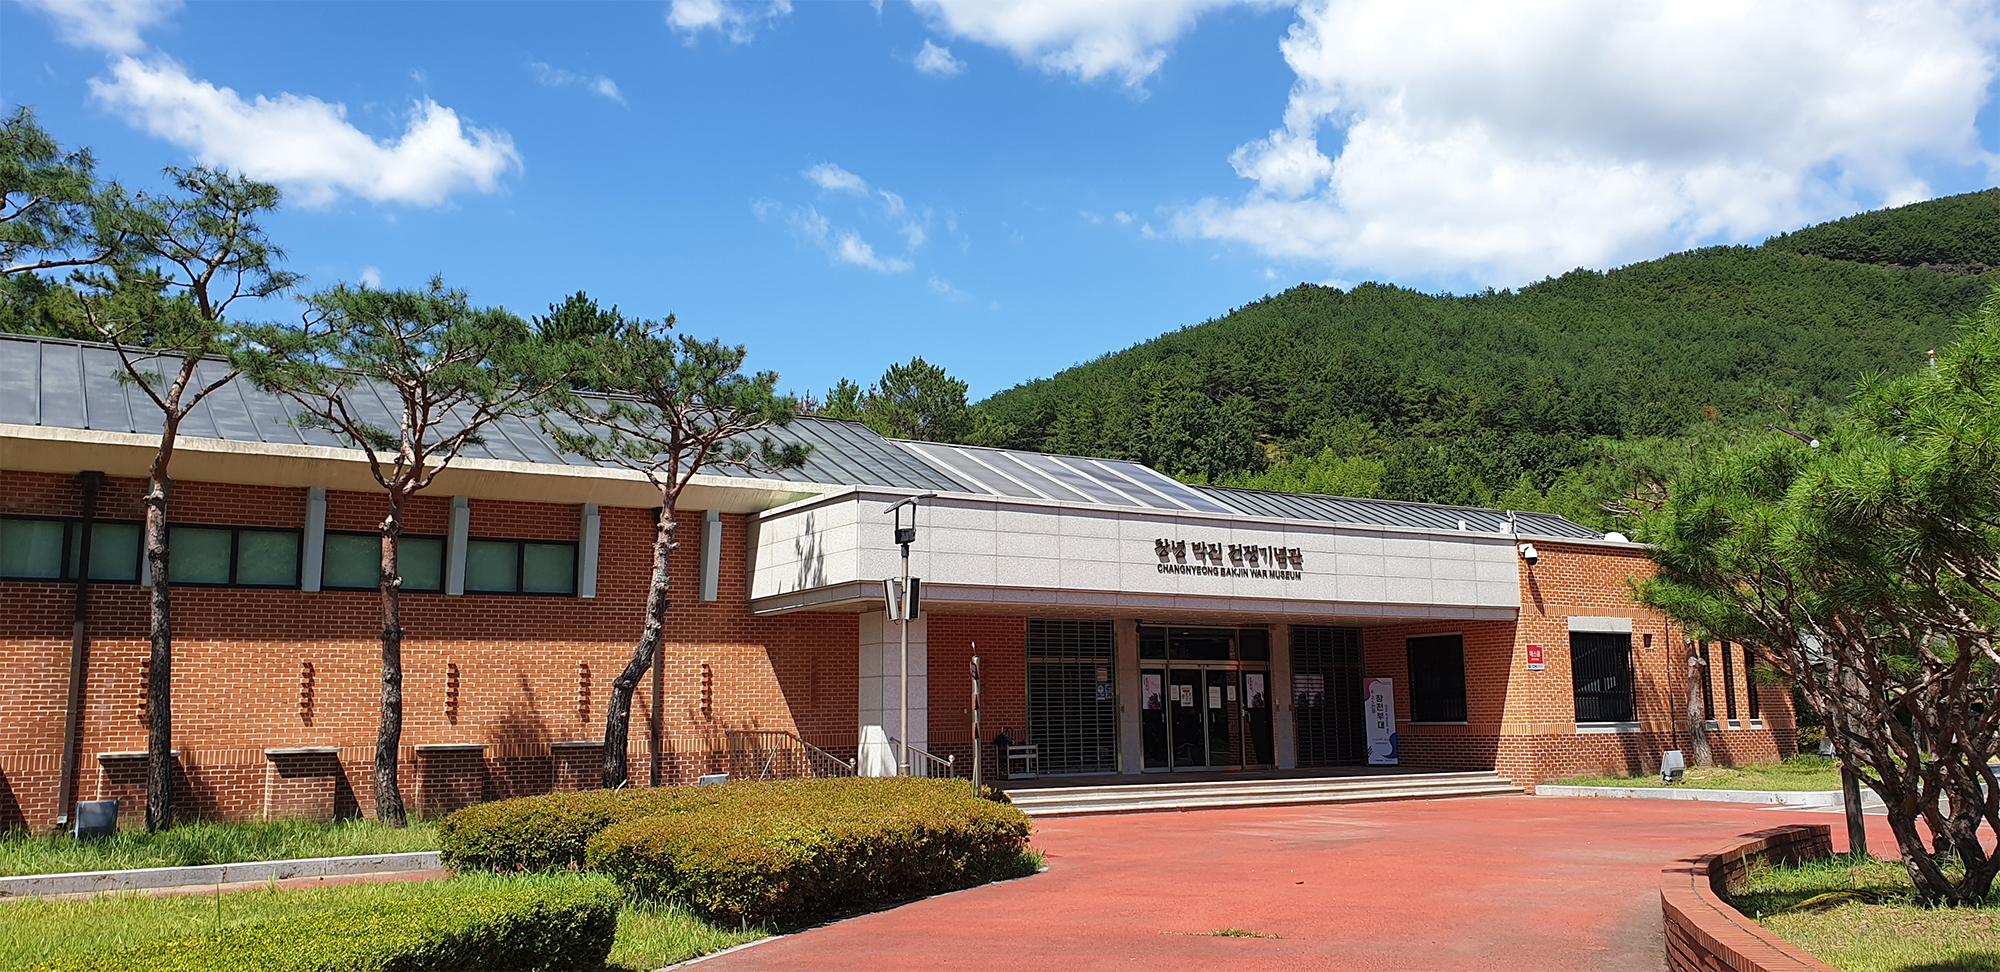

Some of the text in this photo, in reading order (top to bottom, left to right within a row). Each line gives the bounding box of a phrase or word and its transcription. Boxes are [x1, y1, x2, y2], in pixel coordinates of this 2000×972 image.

[1155, 538, 1304, 570] 창녕 박진 전쟁기념관
[1157, 564, 1302, 581] CHANGNYEONG BAKJIN WAR MUSEUM
[1376, 694, 1384, 729] 참전부대
